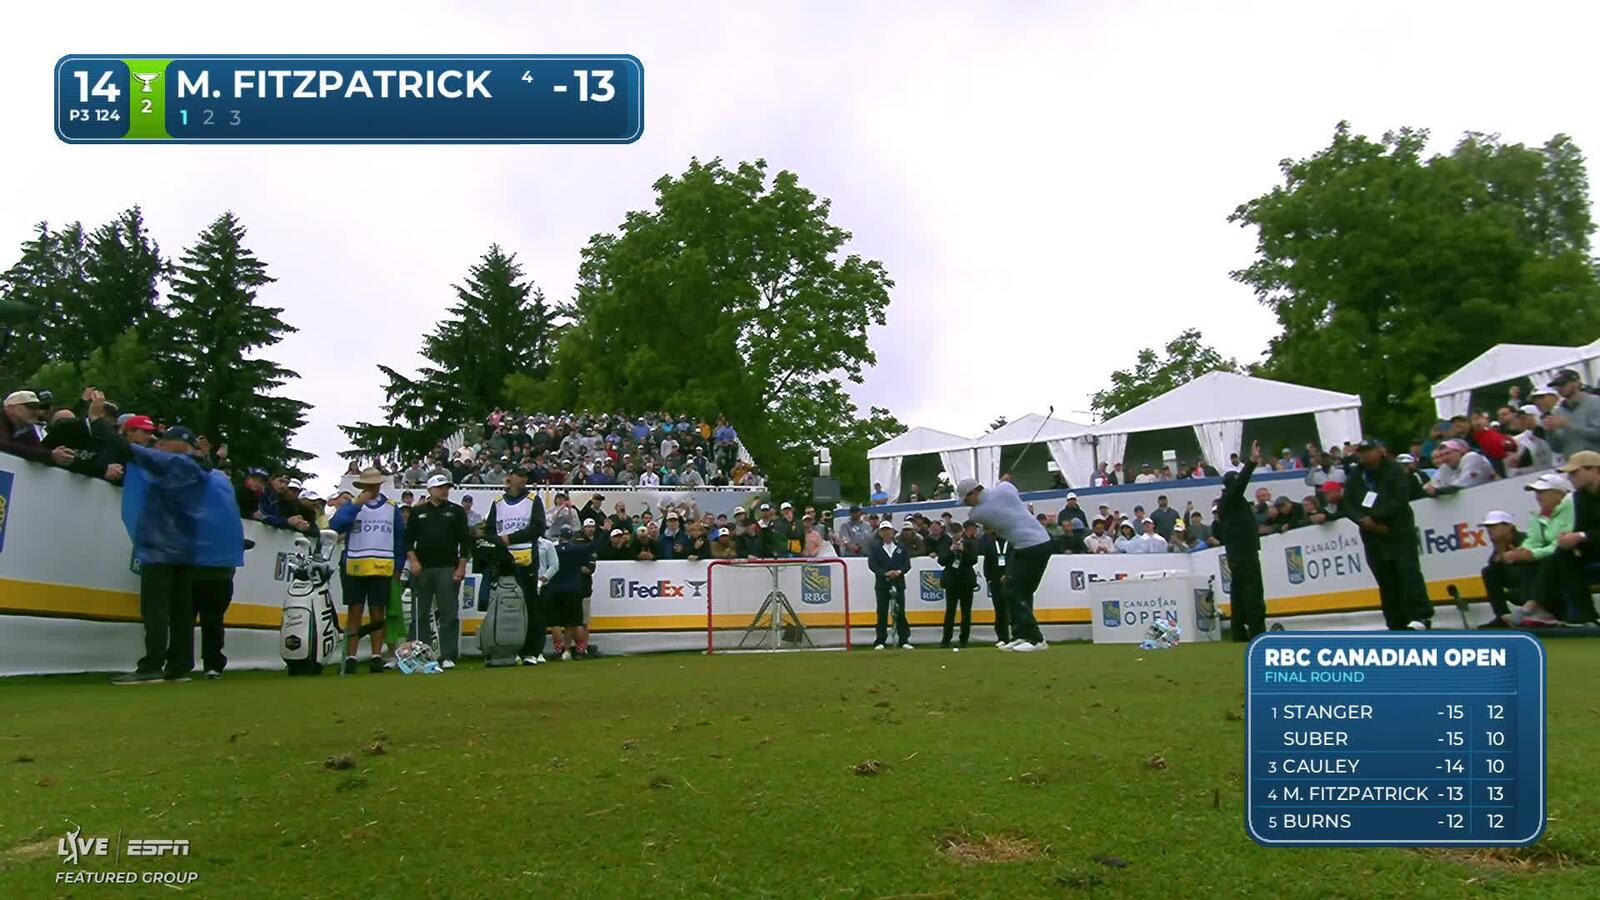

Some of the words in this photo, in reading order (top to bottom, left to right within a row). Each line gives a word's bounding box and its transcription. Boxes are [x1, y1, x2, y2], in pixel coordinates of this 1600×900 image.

[1305, 534, 1359, 555] CANADIAN
[1424, 522, 1489, 554] FedEx
[1307, 554, 1362, 579] OPEN
[629, 580, 684, 598] FedEx
[804, 592, 829, 602] RBC
[922, 592, 942, 600] RBC
[1124, 597, 1177, 608] CANADIAN
[318, 590, 334, 658] PING
